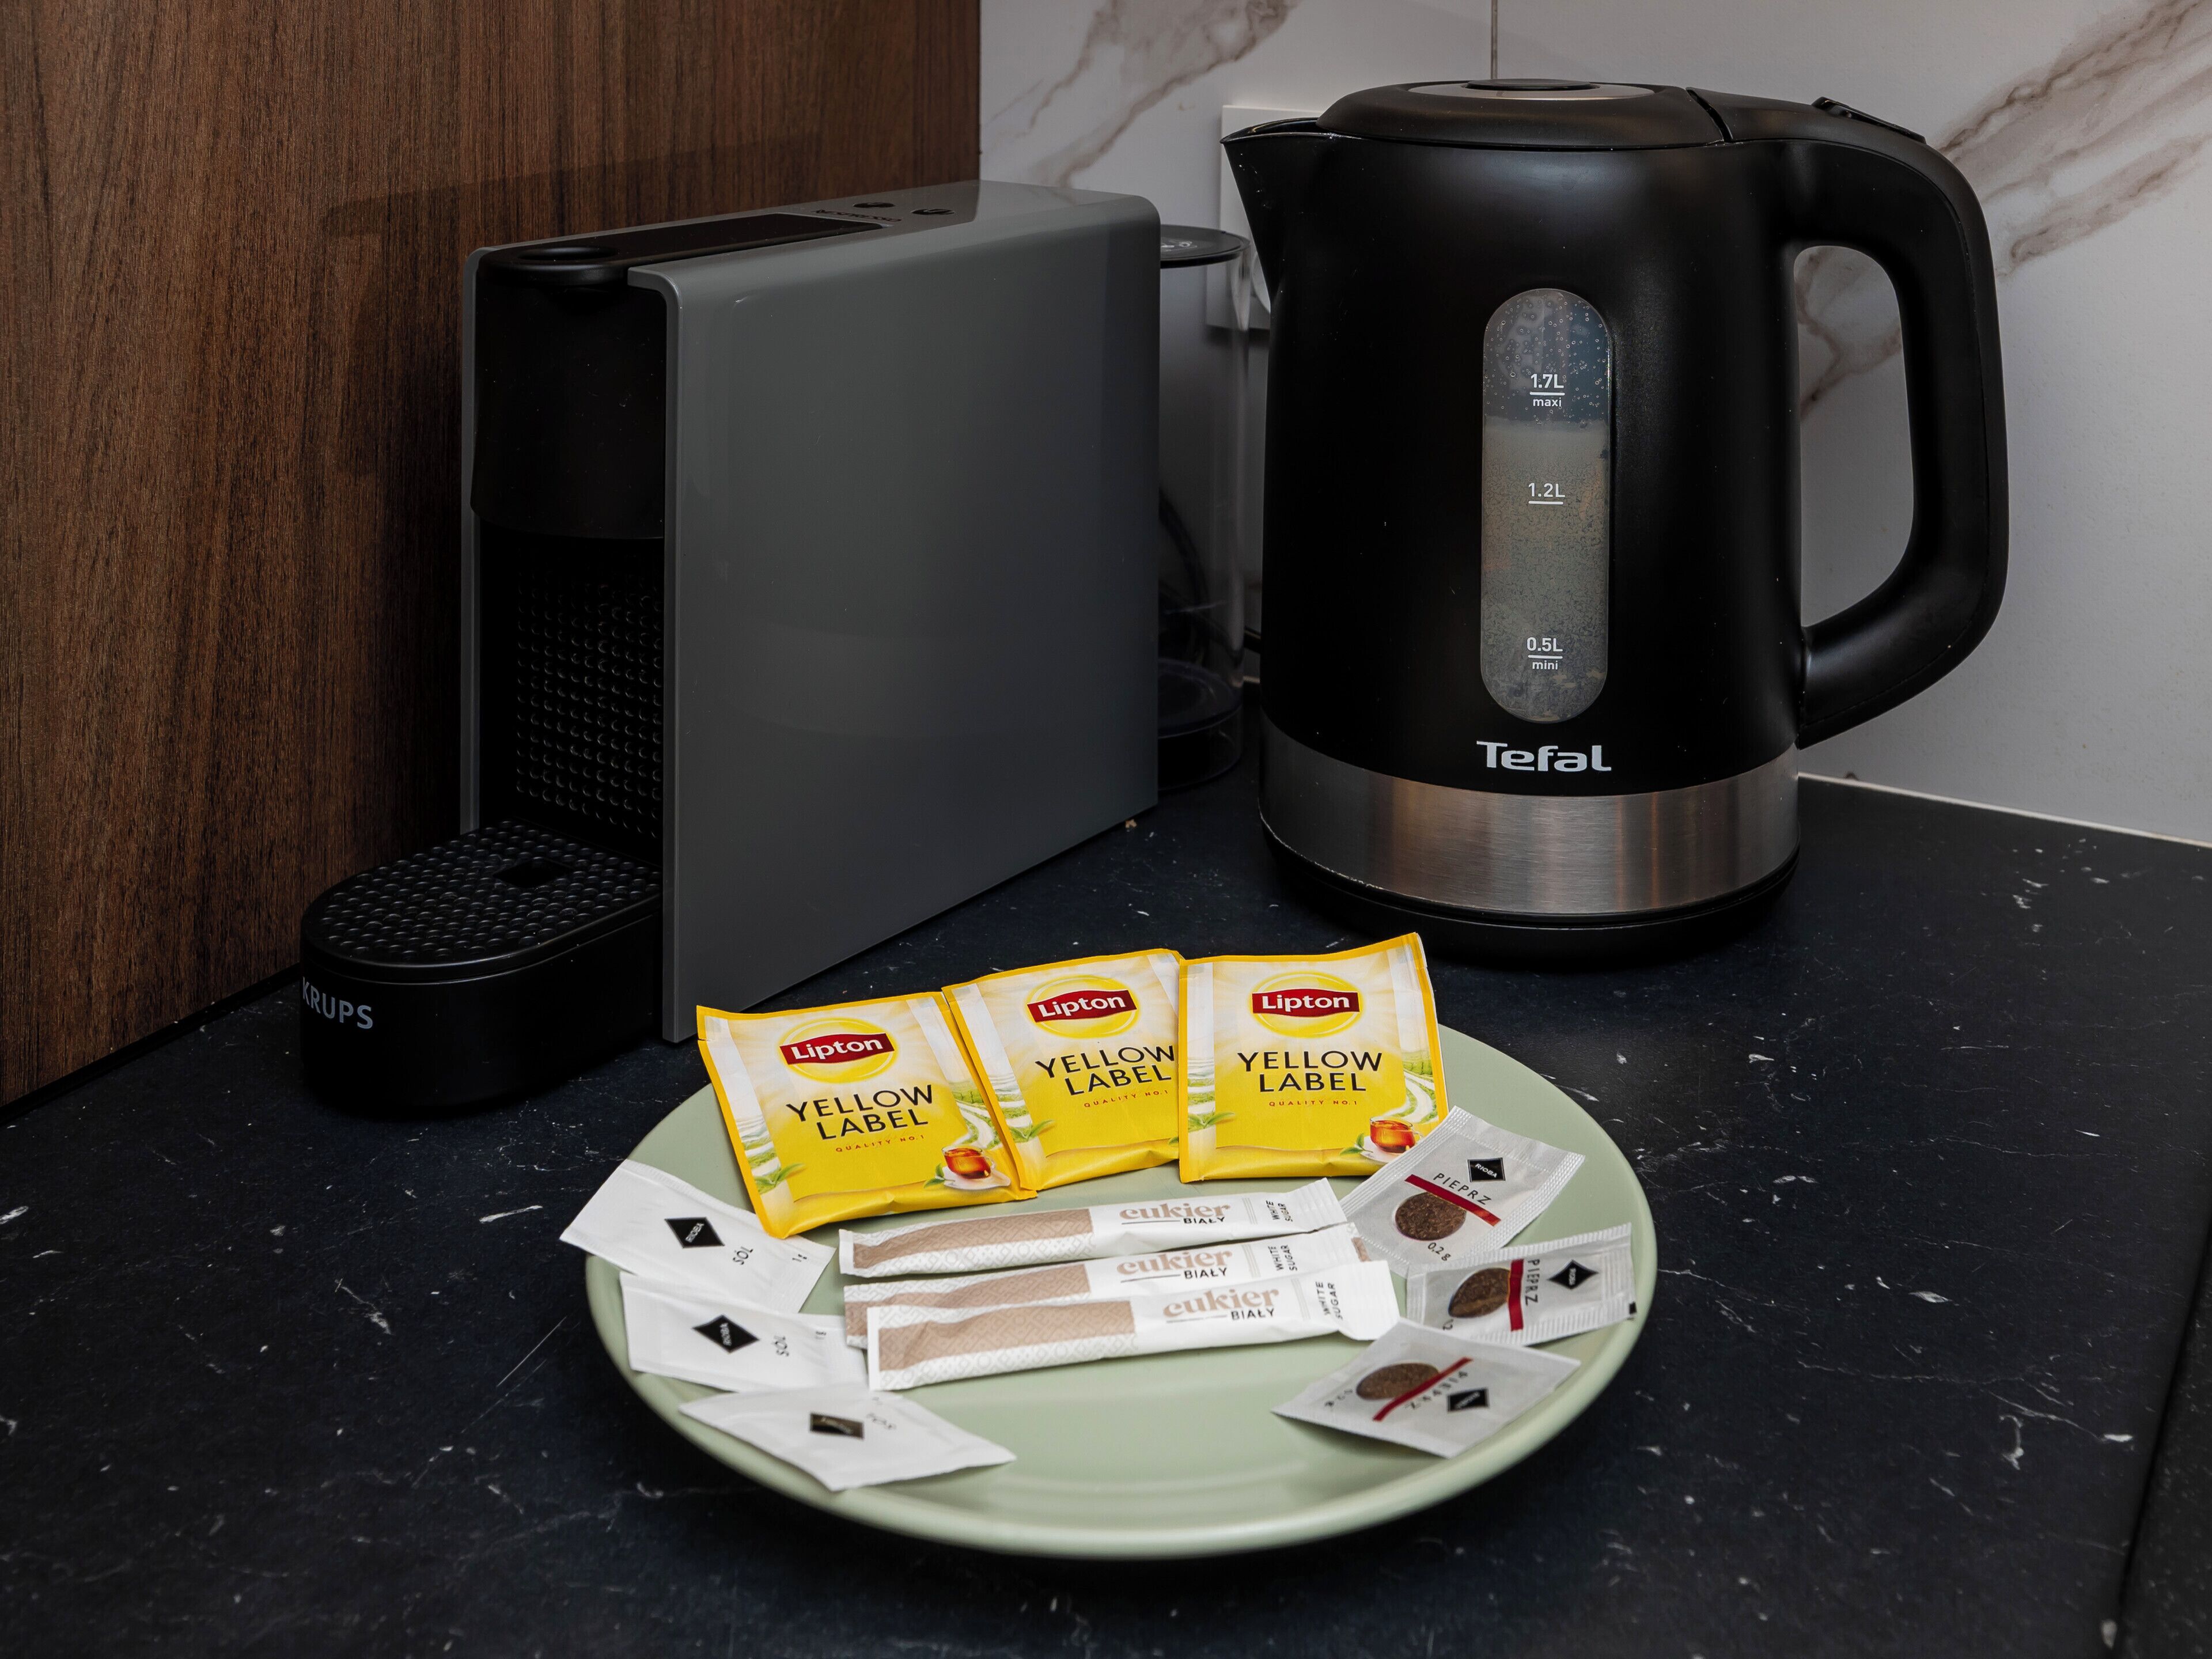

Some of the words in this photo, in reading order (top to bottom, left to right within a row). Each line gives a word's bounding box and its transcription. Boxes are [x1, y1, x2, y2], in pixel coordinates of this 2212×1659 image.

[1529, 372, 1565, 389] 1.7L
[1532, 396, 1562, 407] maxi
[1528, 482, 1565, 498] 1.2L
[1527, 637, 1563, 652] 0.5L
[1532, 659, 1559, 670] mini
[1476, 741, 1611, 772] Tefal
[302, 976, 373, 1029] KRUPS
[1038, 996, 1125, 1017] Lipton
[1262, 995, 1350, 1012] Lipton
[790, 1039, 883, 1060] Lipton
[1035, 1046, 1175, 1078] YELLOW
[1237, 1050, 1382, 1071] YELLOW
[1065, 1065, 1172, 1096] LABEL
[1259, 1073, 1366, 1092] LABEL
[786, 1084, 933, 1122] YELLOW
[1084, 1093, 1137, 1108] QUALITY
[816, 1111, 929, 1141] LABEL
[835, 1139, 891, 1152] QUALITY
[1475, 1163, 1498, 1178] RIOBA
[1433, 1173, 1492, 1205] PIEPRZ
[1119, 1203, 1230, 1219] cukier
[1266, 1200, 1280, 1220] WHITE
[1278, 1203, 1293, 1222] SUGAR
[733, 1246, 753, 1265] SÓL
[1268, 1246, 1284, 1271] WHITE
[1281, 1245, 1297, 1271] SUGAR
[1427, 1242, 1444, 1255] 0,2
[1117, 1250, 1232, 1275] cukier
[1184, 1268, 1227, 1279] BIAŁY
[1524, 1259, 1540, 1306] PIEPRZ
[1163, 1289, 1279, 1317] cukier
[1315, 1281, 1330, 1316] WHITE
[1328, 1283, 1342, 1320] SUGAR
[1231, 1309, 1274, 1320] BIAŁY
